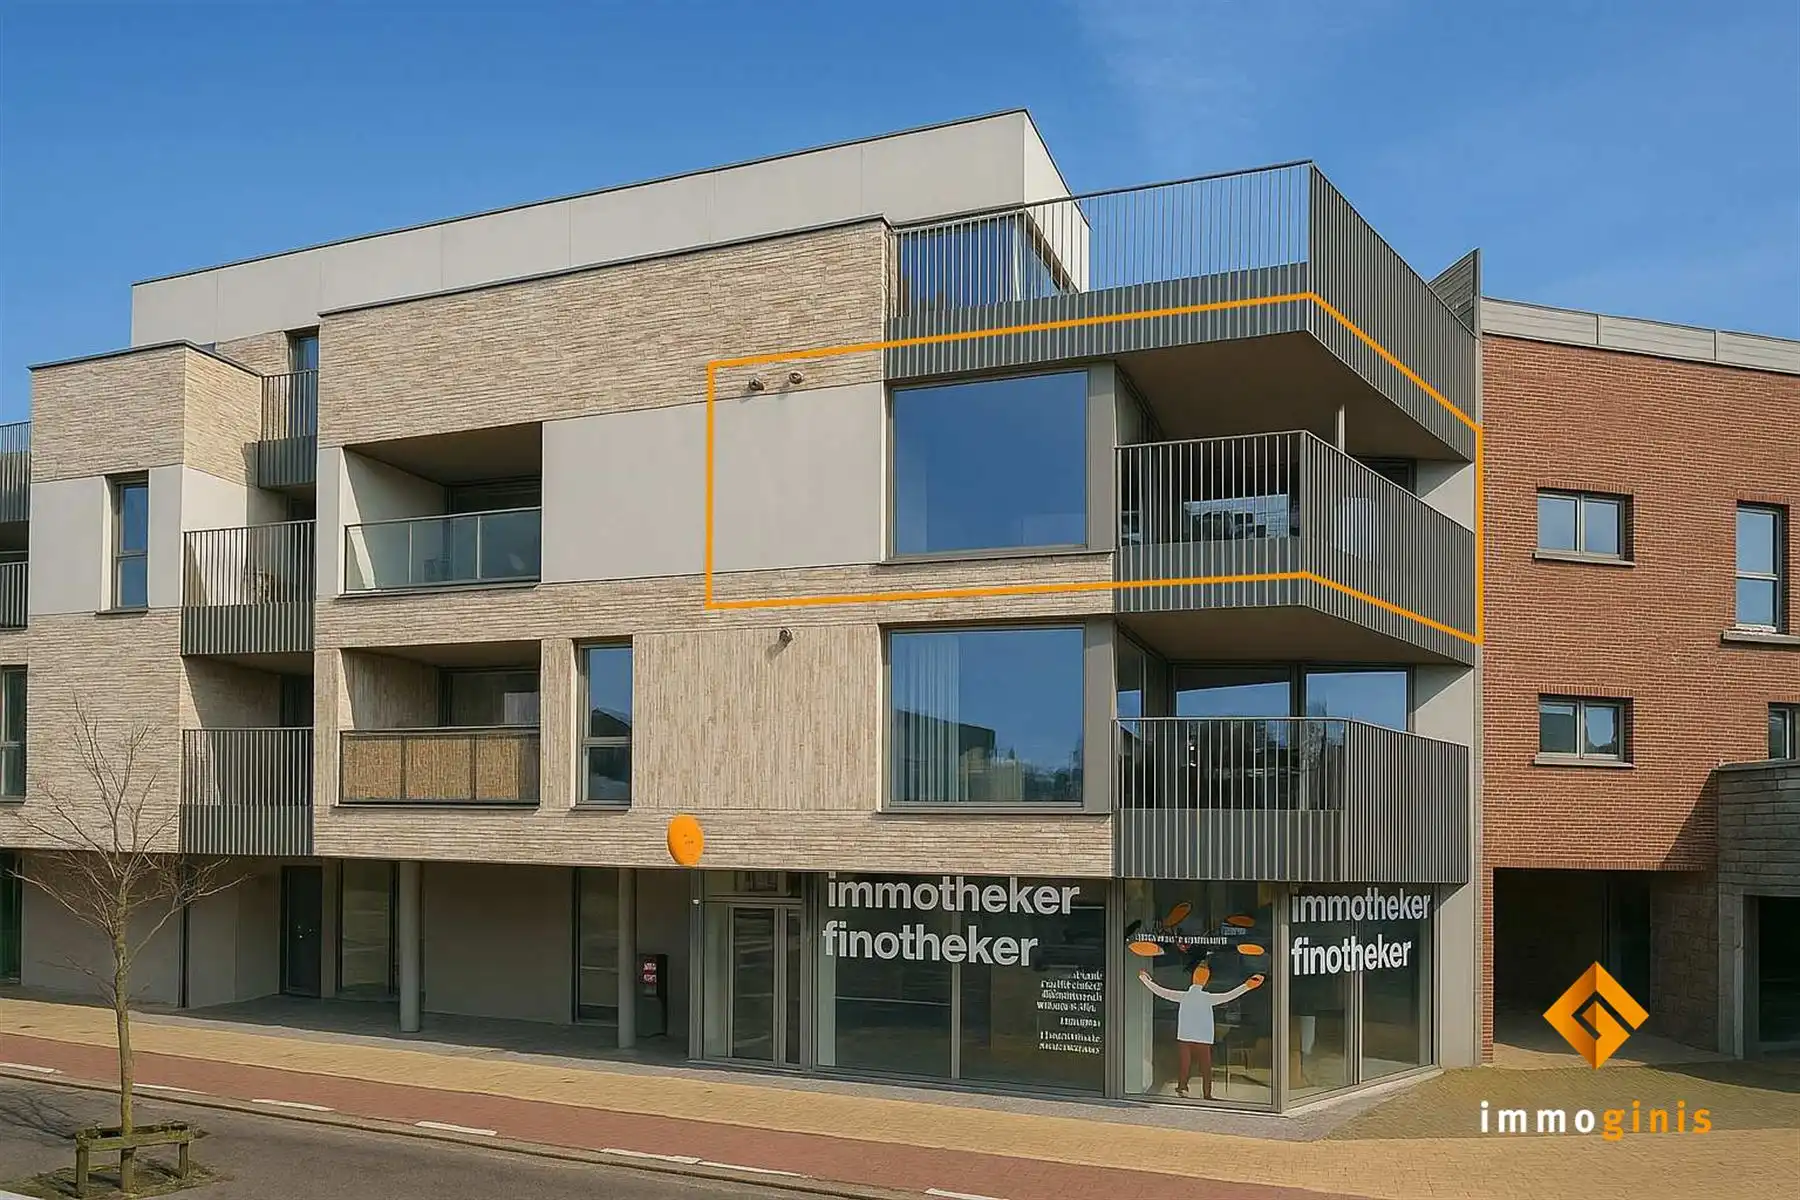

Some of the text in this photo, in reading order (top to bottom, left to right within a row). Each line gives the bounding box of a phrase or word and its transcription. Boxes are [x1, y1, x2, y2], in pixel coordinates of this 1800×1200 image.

[828, 872, 1080, 915] immotheker
[1292, 887, 1430, 923] immotheker
[822, 921, 1038, 966] finotheker
[1291, 934, 1412, 976] finotheker
